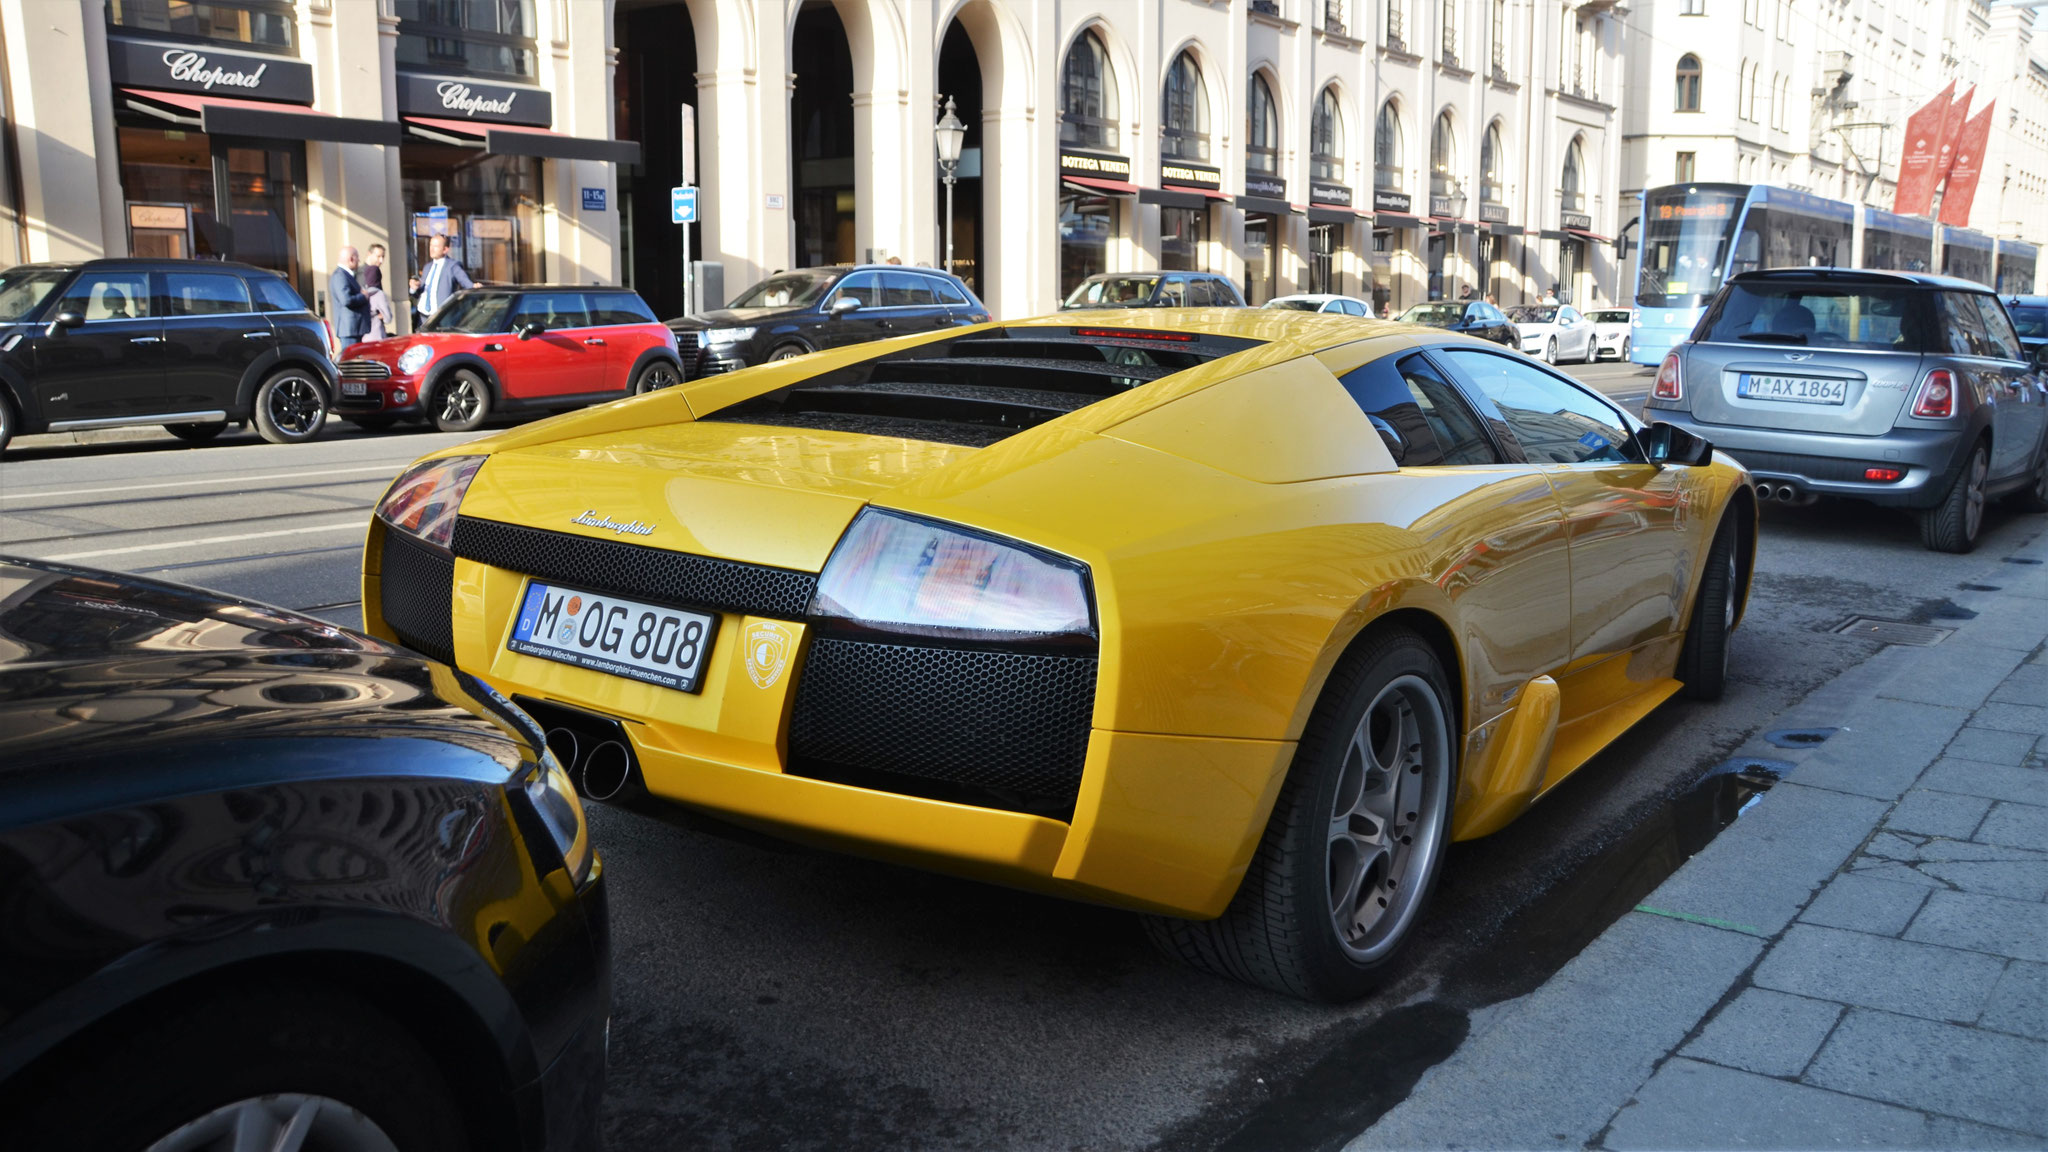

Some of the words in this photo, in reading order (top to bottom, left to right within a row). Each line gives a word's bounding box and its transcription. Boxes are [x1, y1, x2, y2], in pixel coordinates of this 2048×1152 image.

[163, 50, 267, 89] Chopard
[437, 81, 517, 116] Chopard
[1062, 155, 1099, 171] BOTTEGA
[1099, 160, 1129, 174] VENETA
[1162, 166, 1194, 179] BOTTEGA
[1194, 170, 1220, 183] VENETA
[1435, 201, 1450, 212] BAL
[1484, 206, 1504, 219] BALLY
[1749, 377, 1761, 393] M
[1771, 379, 1793, 396] AX
[1797, 381, 1842, 399] 1864
[571, 510, 656, 535] Lamborghini
[521, 619, 530, 631] D
[534, 593, 564, 639] M
[579, 601, 629, 654] OG
[631, 612, 703, 669] 808
[752, 631, 784, 642] SECURITY
[519, 643, 552, 656] Lamborghini
[552, 648, 577, 662] München
[581, 656, 676, 686] www.lamborghini-muenchen.com
